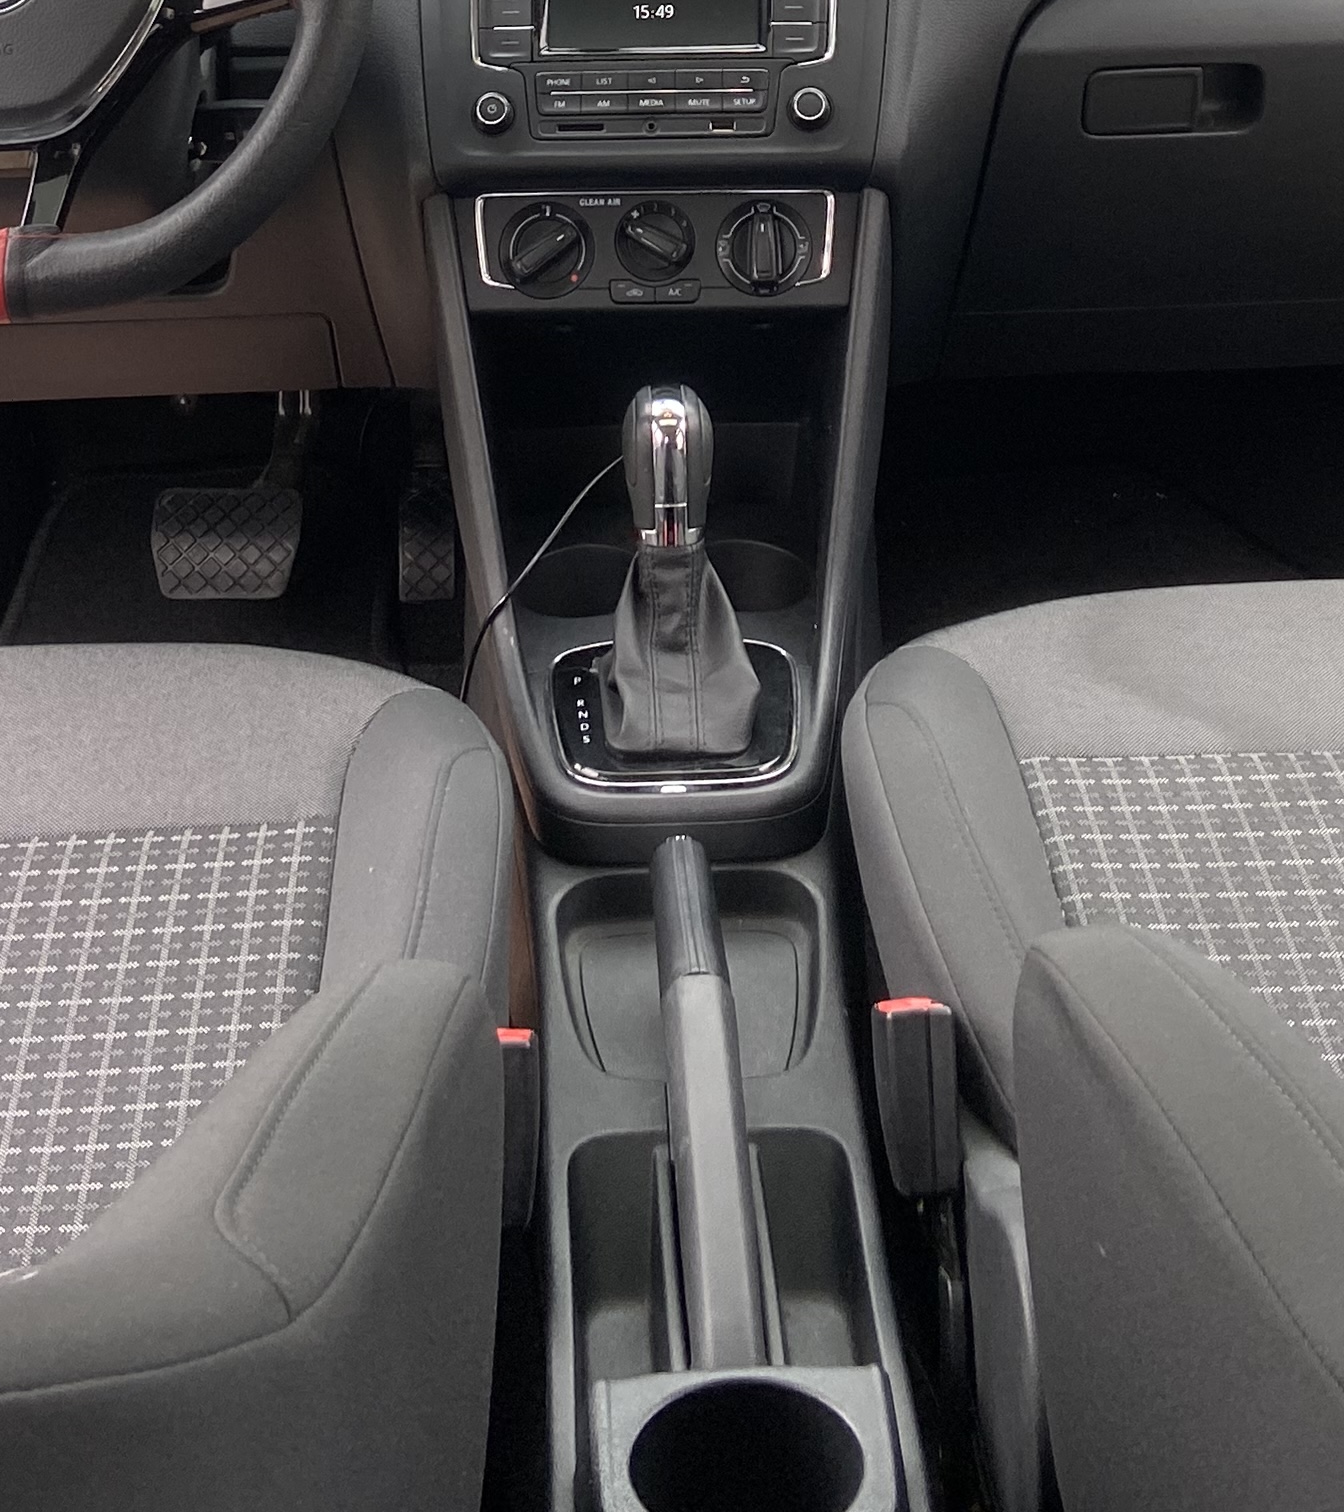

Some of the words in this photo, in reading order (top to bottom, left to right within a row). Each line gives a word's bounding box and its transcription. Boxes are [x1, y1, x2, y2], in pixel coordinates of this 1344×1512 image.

[633, 4, 674, 19] 15:49
[546, 78, 571, 86] PHONE
[596, 77, 612, 85] LIST
[554, 100, 566, 108] FM
[639, 99, 664, 107] MEDIA
[687, 99, 710, 107] MUTE
[733, 97, 756, 106] SETUP
[579, 198, 605, 207] CLEAN
[607, 198, 621, 206] AIR
[573, 676, 582, 685] P
[576, 699, 585, 707] R
[578, 710, 589, 719] N
[580, 722, 590, 731] D
[582, 735, 591, 744] S
